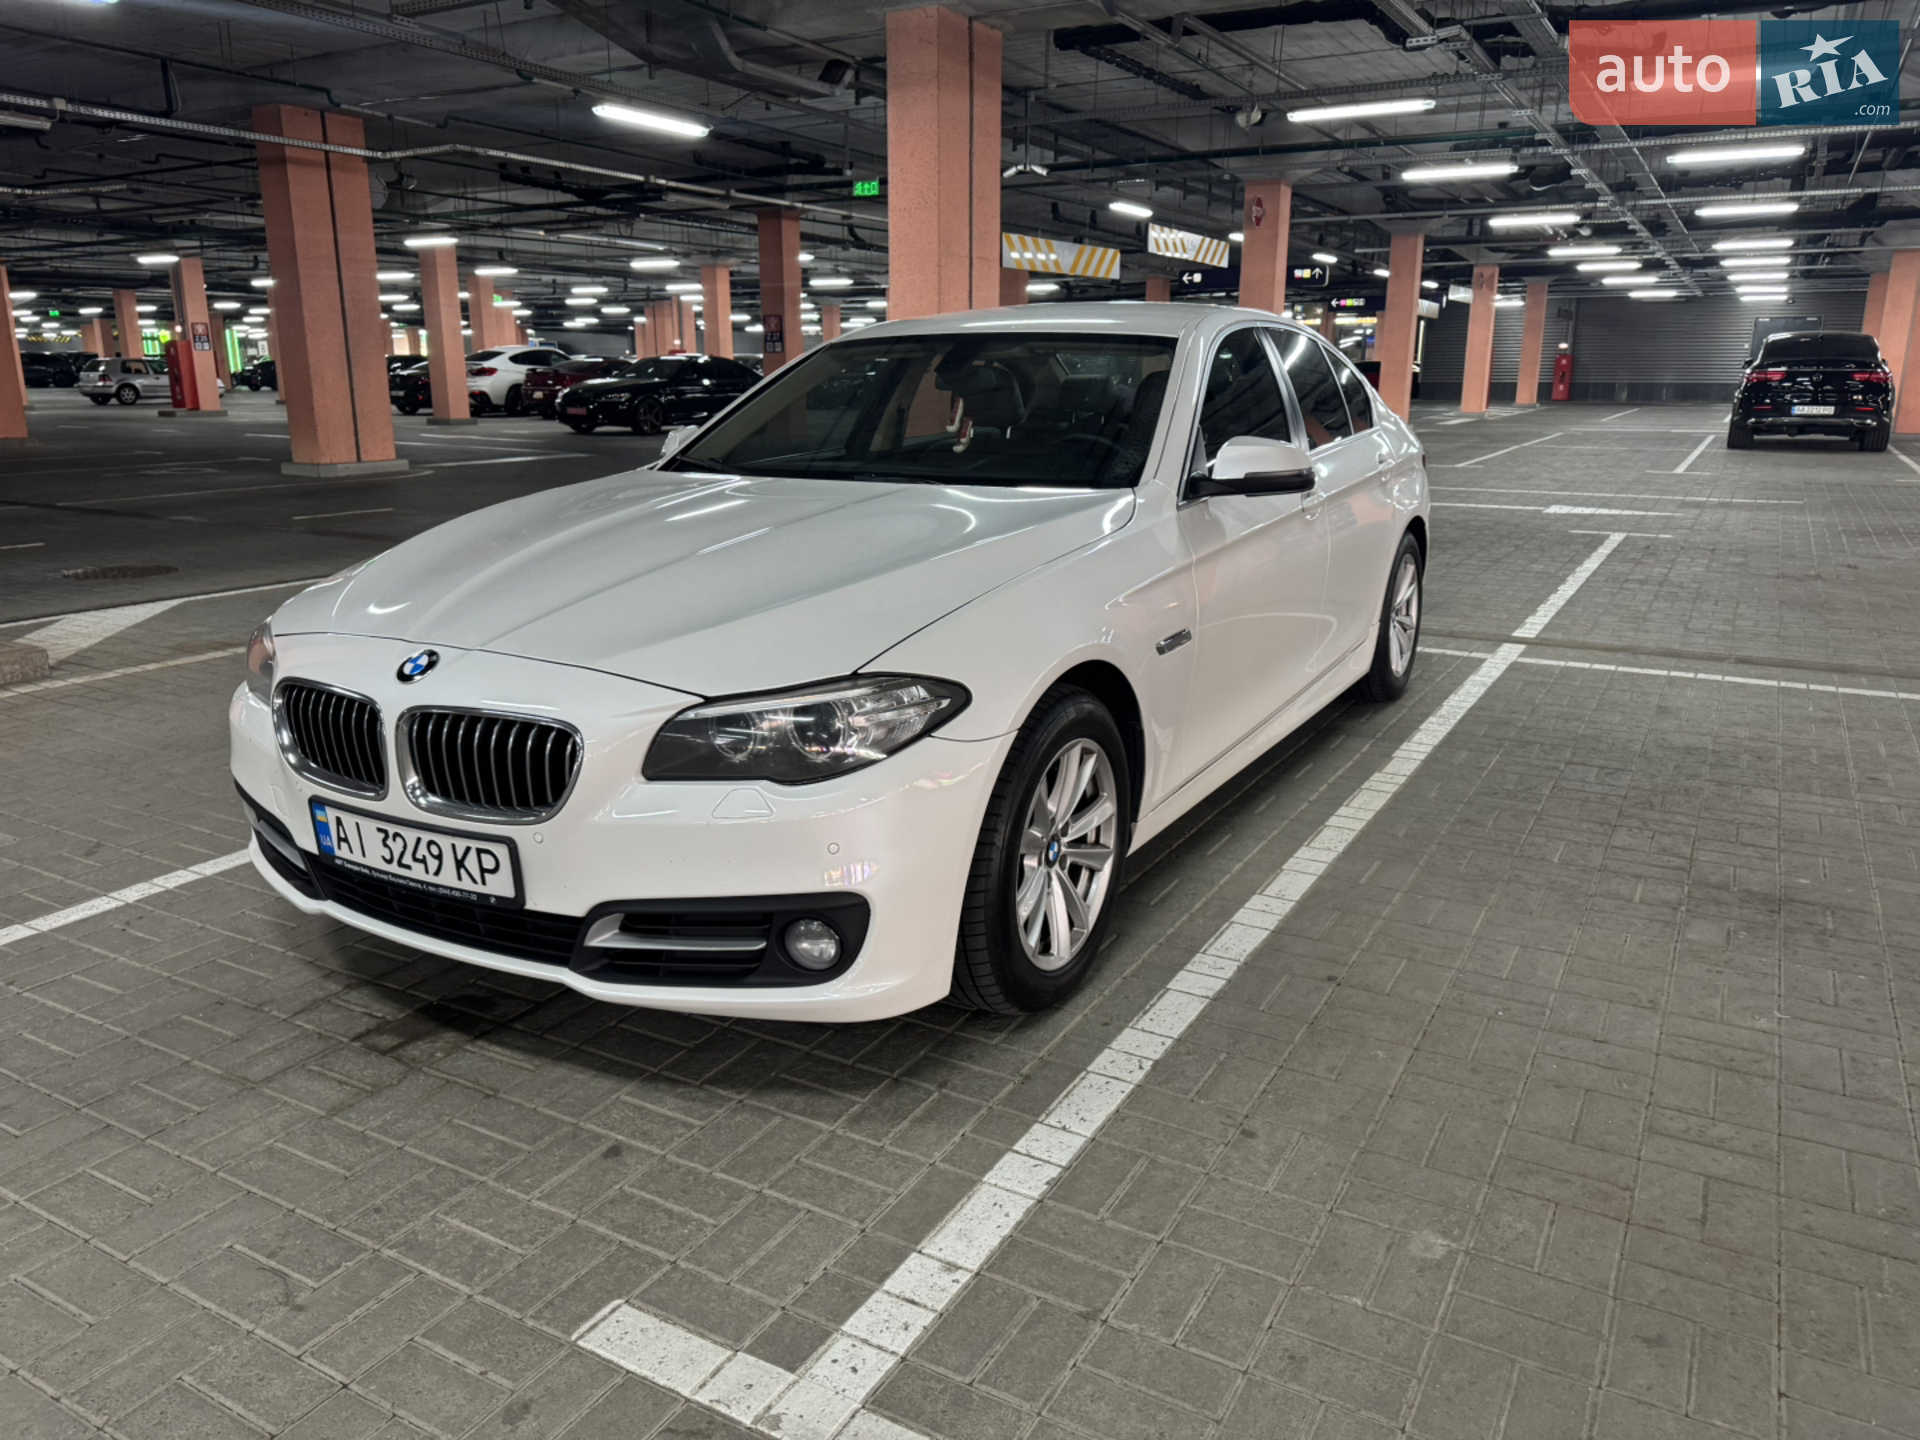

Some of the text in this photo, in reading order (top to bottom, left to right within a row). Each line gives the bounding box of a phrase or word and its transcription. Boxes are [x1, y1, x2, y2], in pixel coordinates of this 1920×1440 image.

[320, 834, 333, 847] UA
[335, 816, 366, 858] AI
[376, 827, 443, 877] 3249
[451, 843, 500, 886] KP
